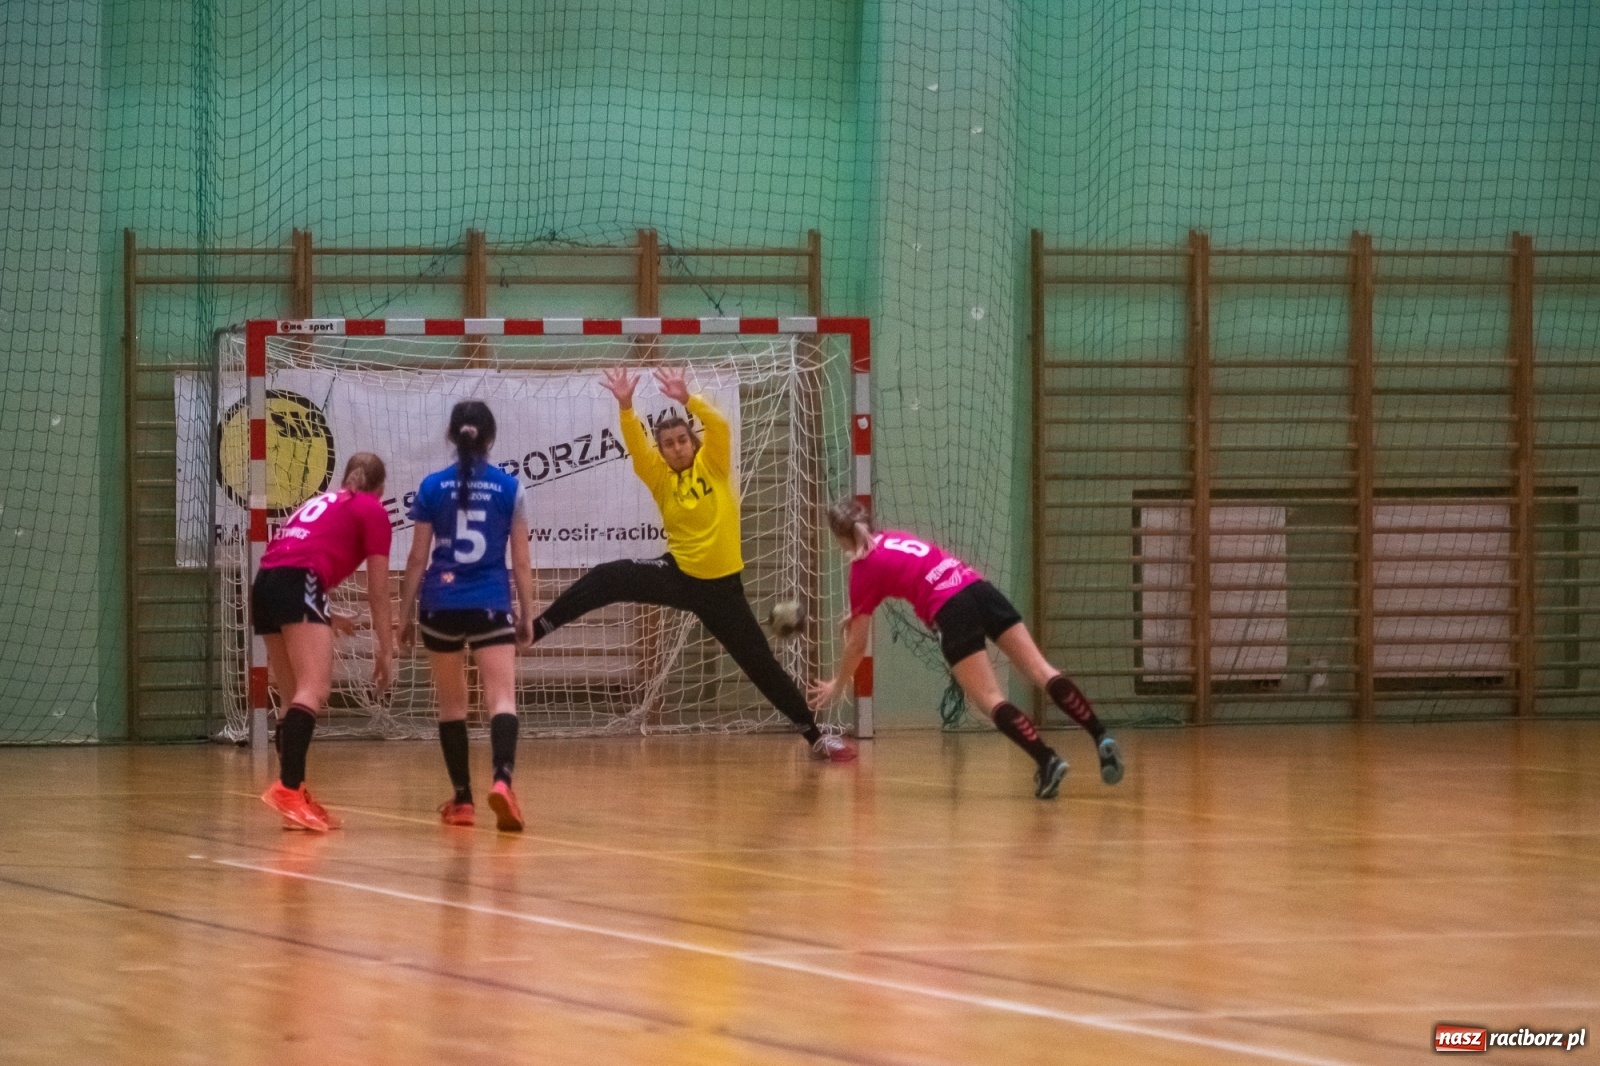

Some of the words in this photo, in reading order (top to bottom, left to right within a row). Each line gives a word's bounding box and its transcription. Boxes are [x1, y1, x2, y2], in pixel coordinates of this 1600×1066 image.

[309, 323, 334, 332] sport
[690, 478, 713, 500] 12
[453, 509, 487, 564] 5
[884, 538, 930, 558] 6
